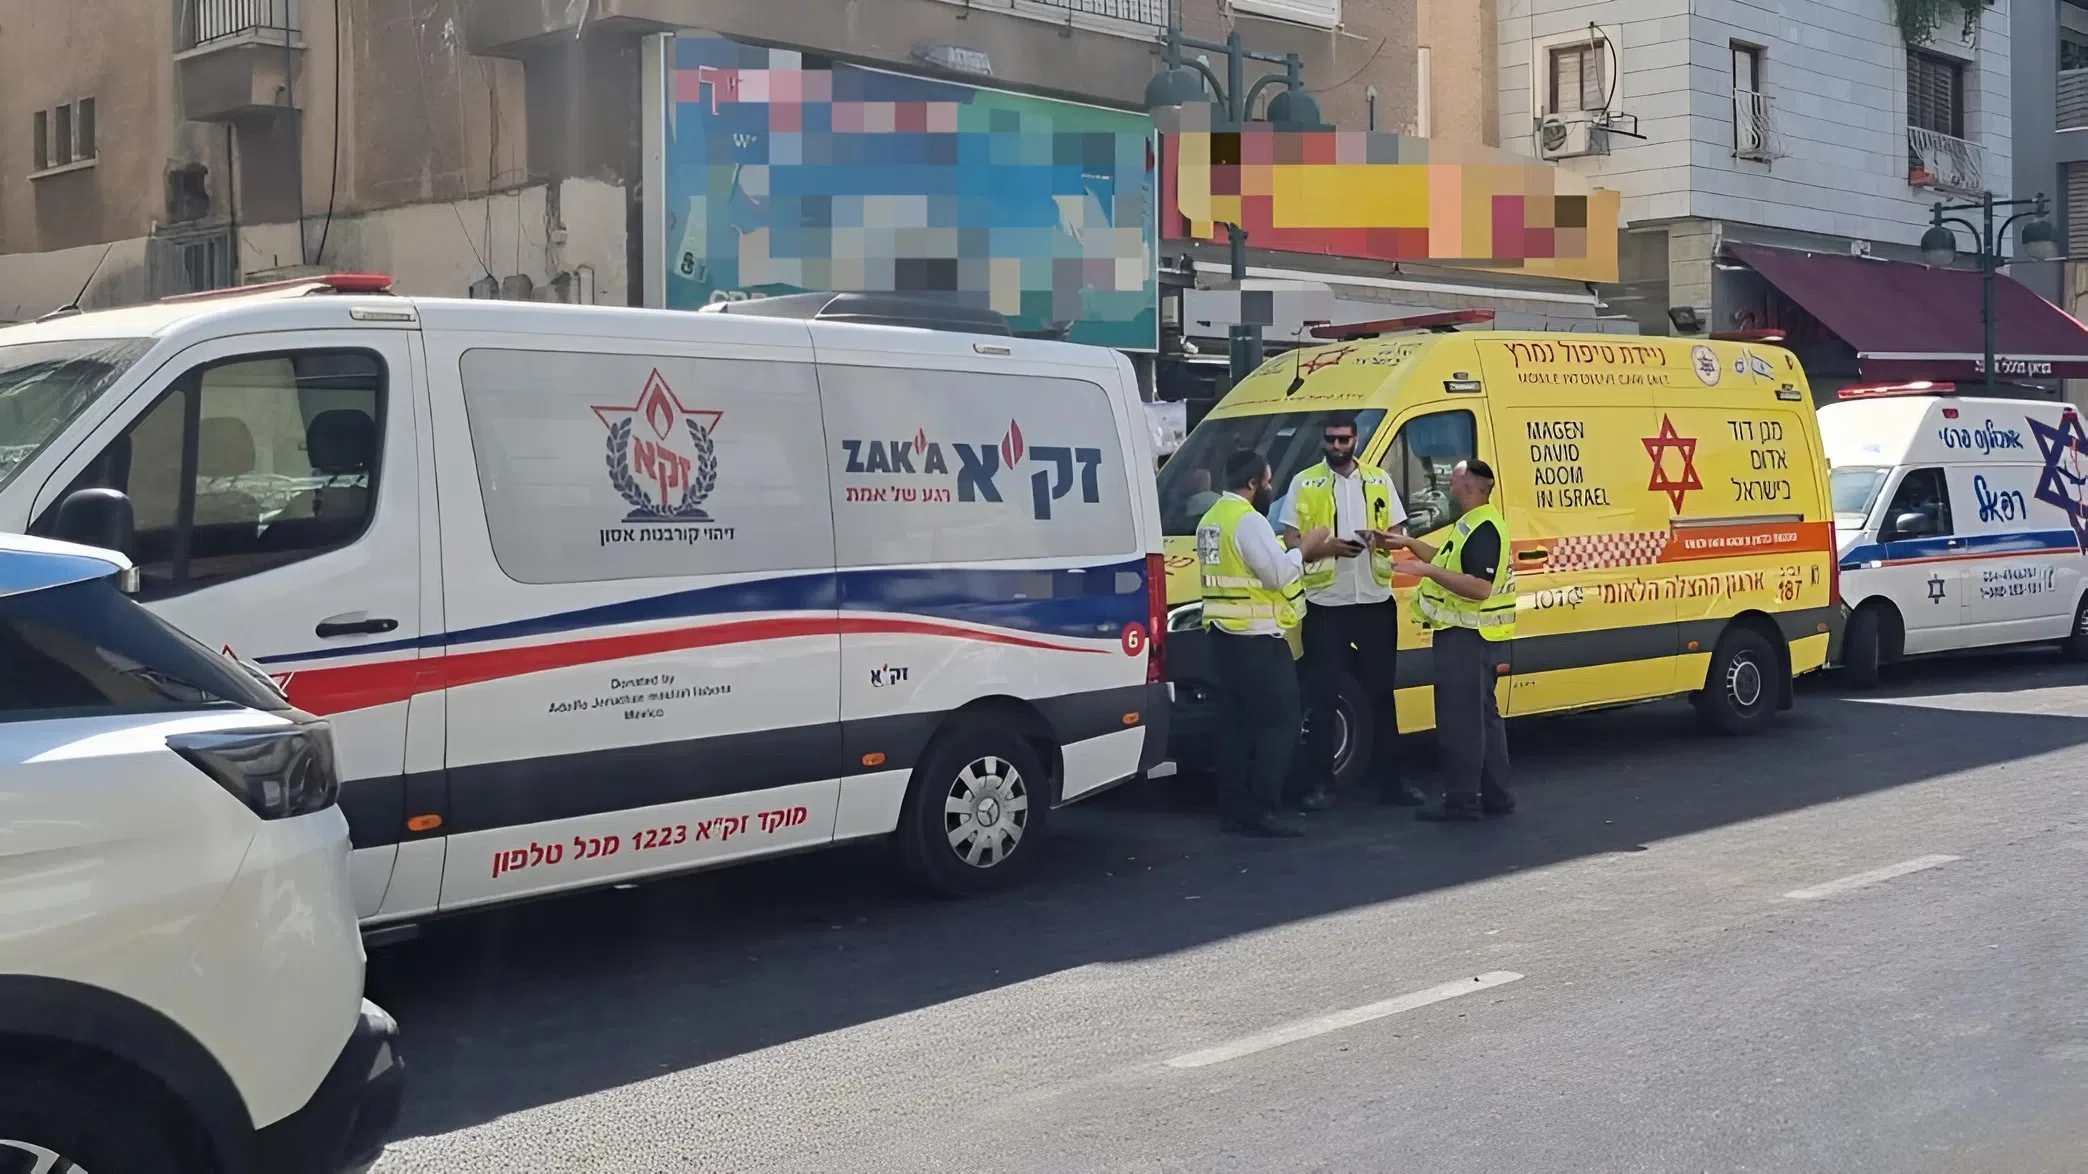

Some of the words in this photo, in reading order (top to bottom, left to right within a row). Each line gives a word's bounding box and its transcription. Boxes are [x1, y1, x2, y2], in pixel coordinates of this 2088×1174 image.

[1504, 343, 1555, 368] נמרץ
[1557, 340, 1615, 364] טיפול
[1526, 421, 1584, 440] MAGEN
[1727, 420, 1754, 441] דוד
[1530, 443, 1580, 463] DAVID
[1750, 448, 1788, 470] אדום
[1535, 466, 1584, 486] ADOM
[846, 486, 887, 502] אמת
[891, 486, 916, 502] של
[922, 489, 951, 504] רגע
[1536, 489, 1554, 509] IN
[1559, 487, 1611, 508] ISRAEL
[1730, 477, 1791, 502] בישראל
[600, 528, 635, 547] אסון
[640, 527, 699, 546] קורבנות
[703, 527, 736, 542] זיהוי
[1665, 574, 1720, 599] ההצלה
[1127, 630, 1139, 649] 6
[757, 806, 808, 834] מוקד
[573, 835, 620, 861] מכל
[632, 825, 688, 851] 1223
[491, 842, 564, 879] טלפון
